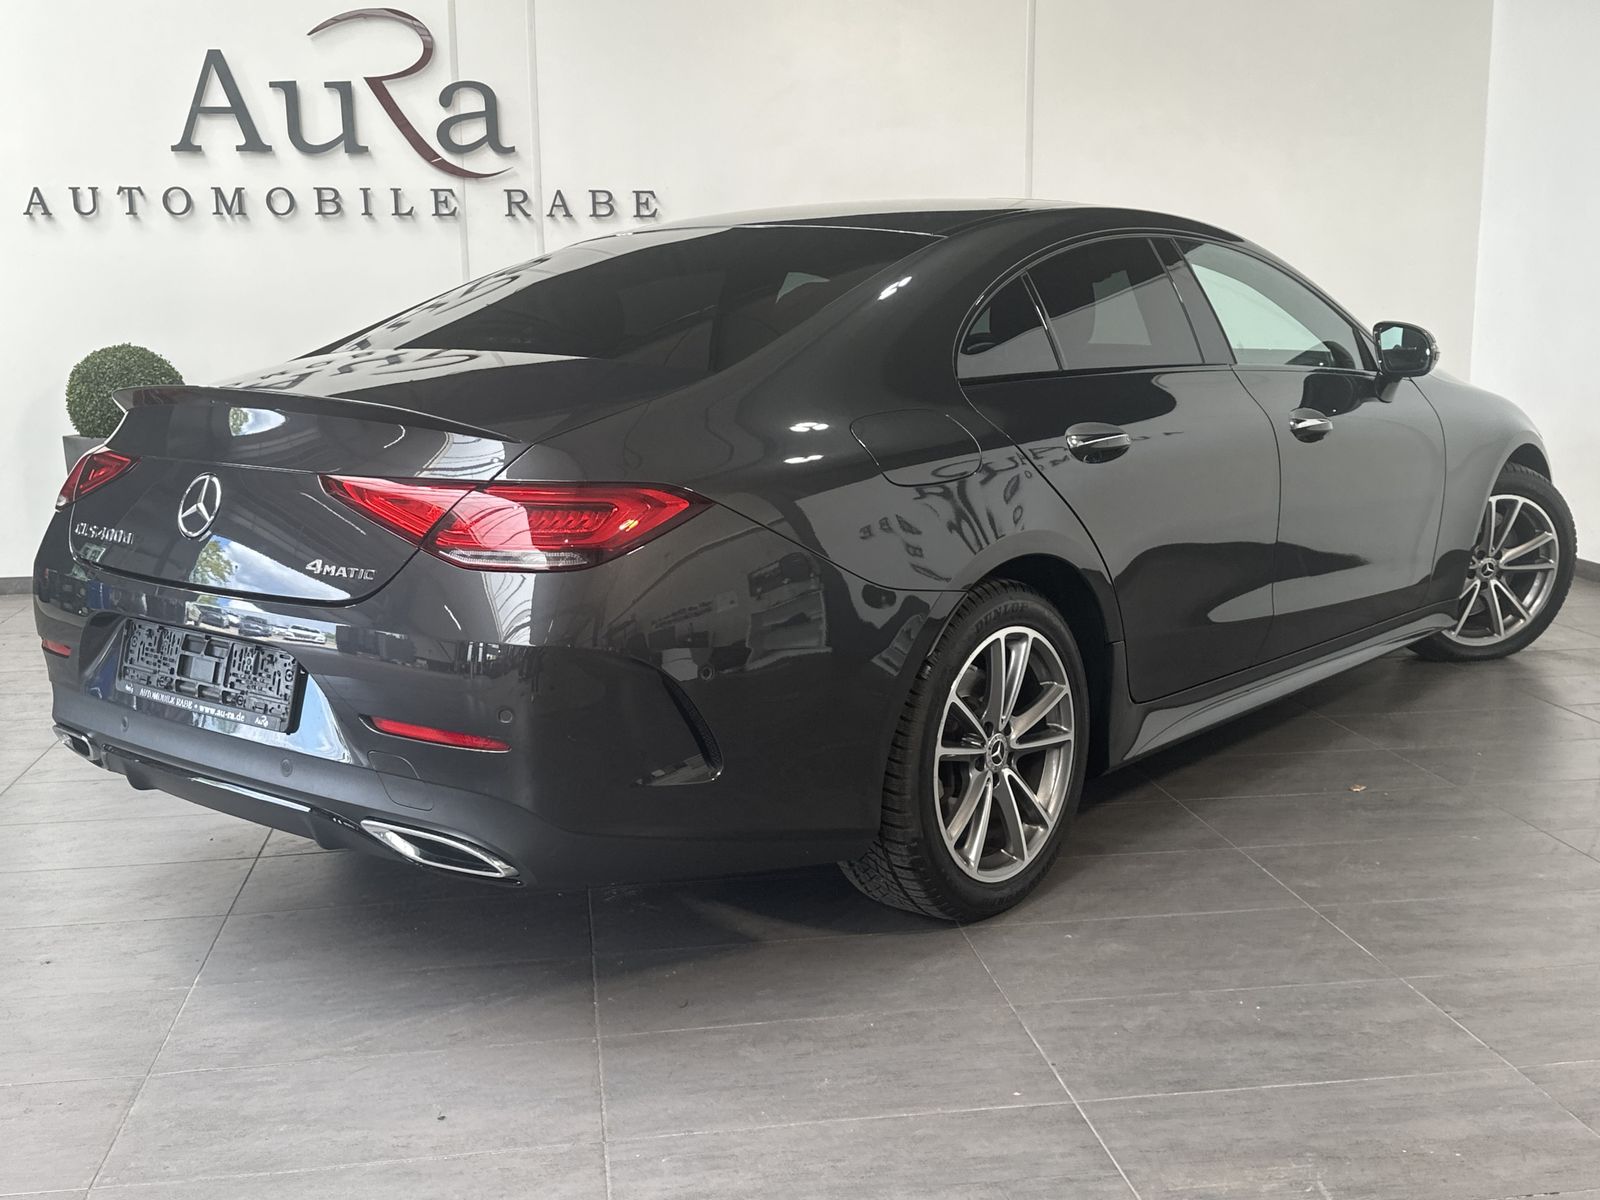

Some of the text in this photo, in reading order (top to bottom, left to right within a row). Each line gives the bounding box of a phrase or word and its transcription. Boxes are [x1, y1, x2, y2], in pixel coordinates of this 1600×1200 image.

[23, 185, 660, 219] AUTOMOBILE RABE
[305, 559, 376, 580] 4MATIC
